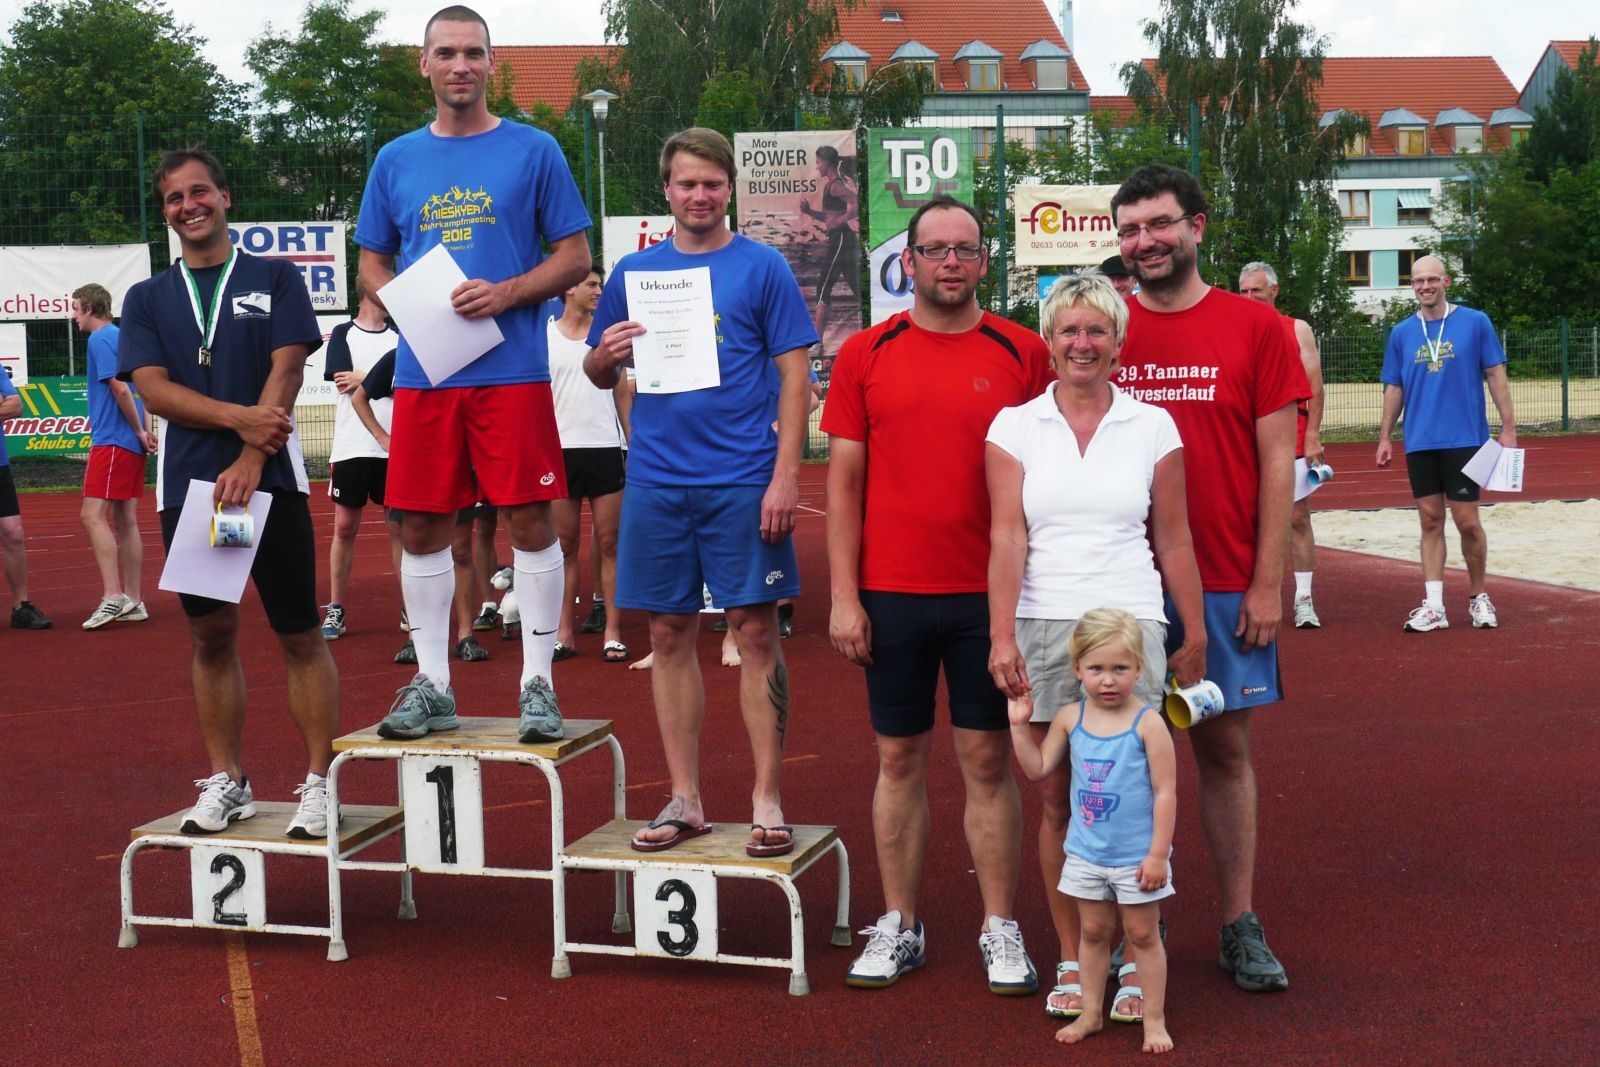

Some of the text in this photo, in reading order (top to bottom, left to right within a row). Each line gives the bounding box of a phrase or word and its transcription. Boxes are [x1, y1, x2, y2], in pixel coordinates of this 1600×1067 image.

[752, 139, 778, 148] More
[742, 149, 807, 167] POWER
[883, 137, 958, 195] TBO
[751, 168, 791, 180] for your
[749, 179, 817, 194] BUSINESS
[420, 216, 496, 232] Mehrkampfmeeting
[441, 227, 472, 243] 2012
[640, 279, 693, 291] Urkunde
[0, 293, 79, 313] chlesi
[25, 435, 75, 450] Schulze
[426, 766, 457, 864] 1
[210, 854, 248, 926] 2
[656, 878, 699, 957] 3
